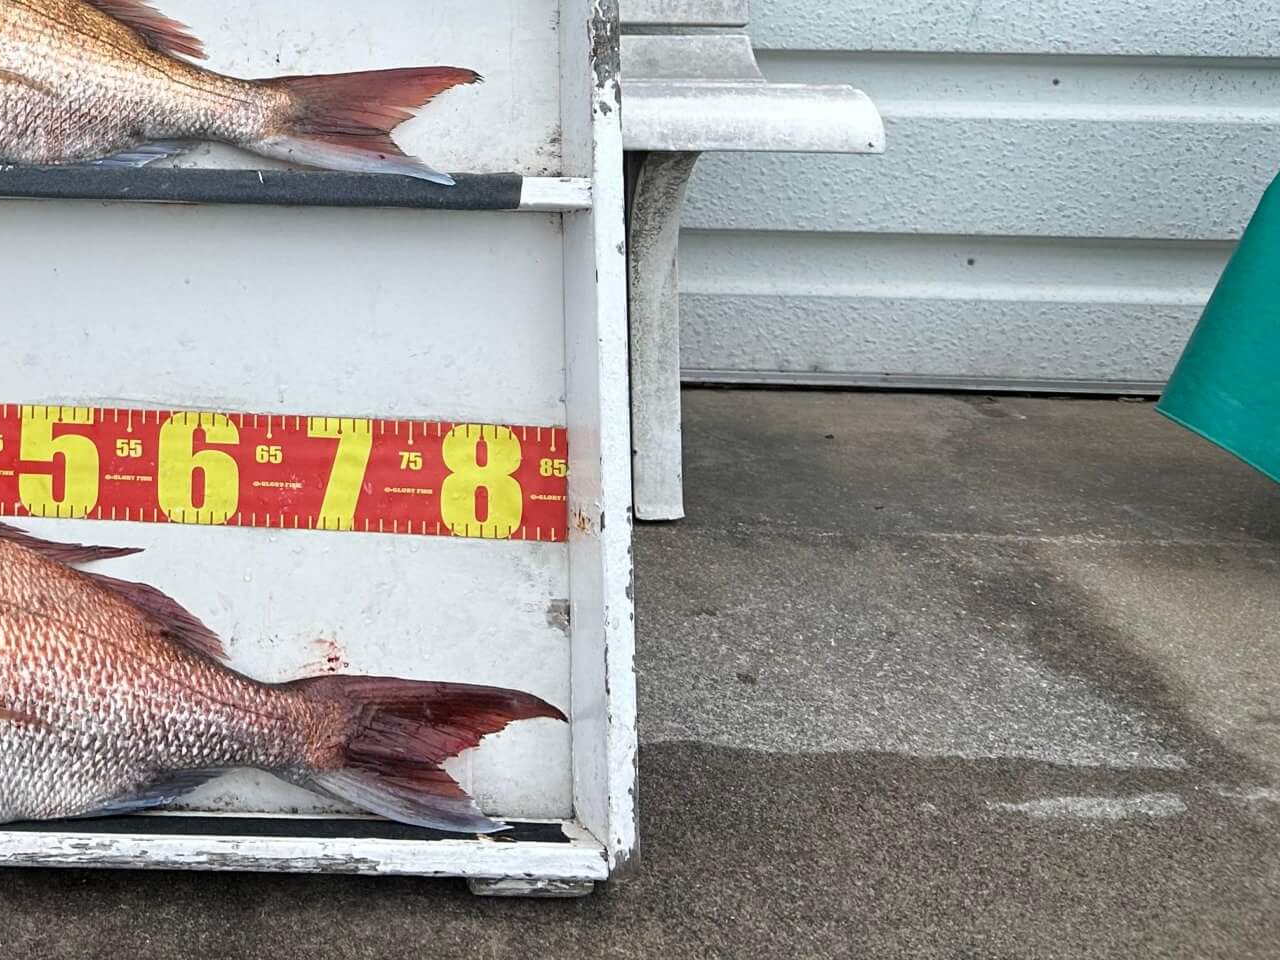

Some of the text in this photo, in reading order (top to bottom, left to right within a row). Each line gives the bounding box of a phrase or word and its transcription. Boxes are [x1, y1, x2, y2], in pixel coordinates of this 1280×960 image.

[19, 405, 99, 518] 5
[116, 439, 142, 458] 55
[157, 412, 240, 525] 6
[255, 445, 283, 464] 65
[307, 416, 373, 529] 7
[399, 452, 423, 470] 75
[440, 424, 522, 538] 8
[539, 458, 566, 477] 85
